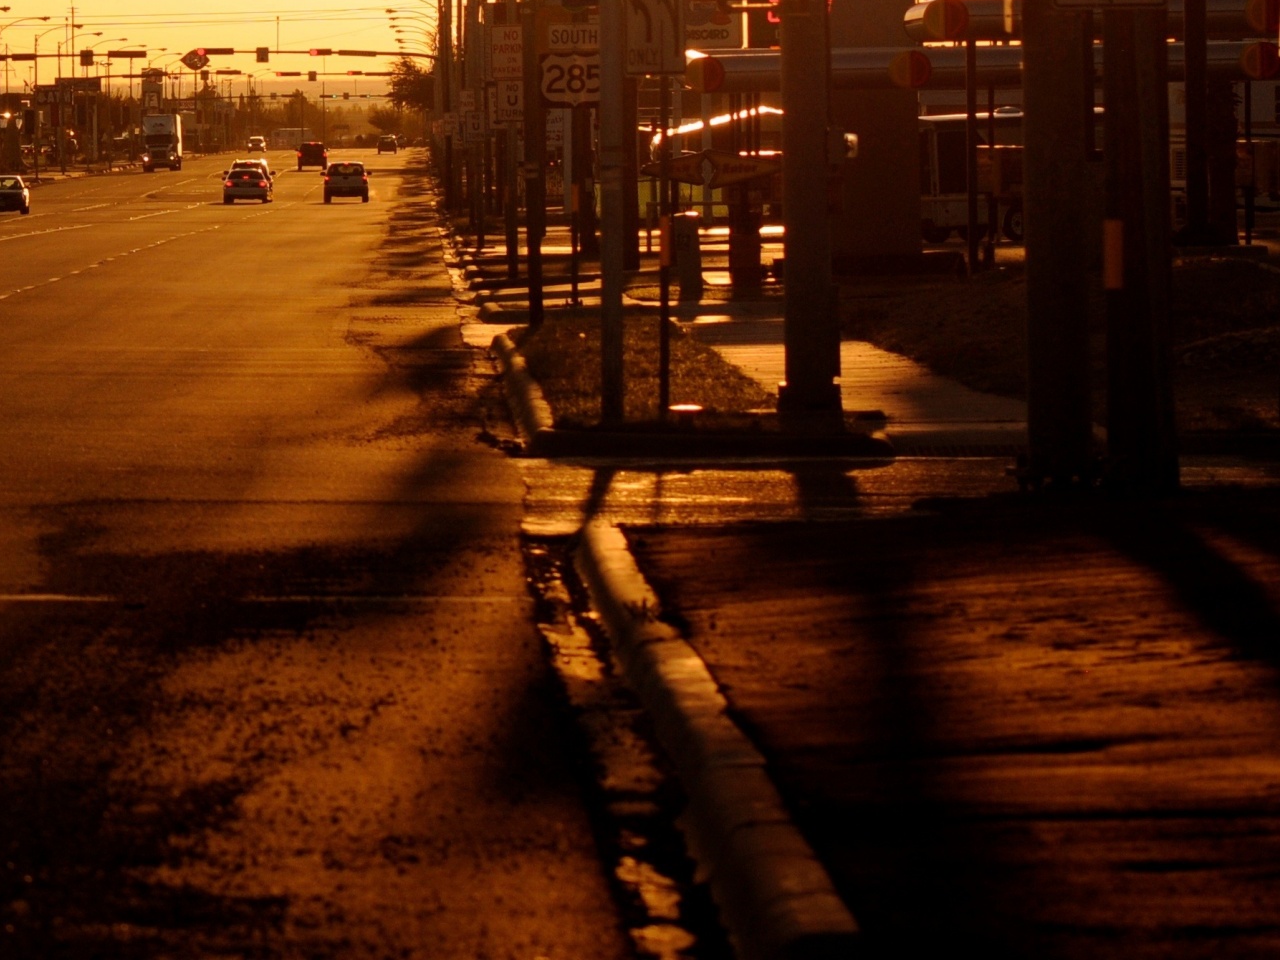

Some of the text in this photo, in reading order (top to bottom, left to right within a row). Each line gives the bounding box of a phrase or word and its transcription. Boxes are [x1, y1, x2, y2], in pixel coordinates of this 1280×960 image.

[503, 30, 519, 41] NO
[551, 29, 598, 45] SOUTH
[493, 43, 523, 54] PARKIN
[628, 48, 658, 66] ONLY
[546, 64, 600, 93] 285
[506, 84, 519, 92] NO
[507, 95, 518, 106] U
